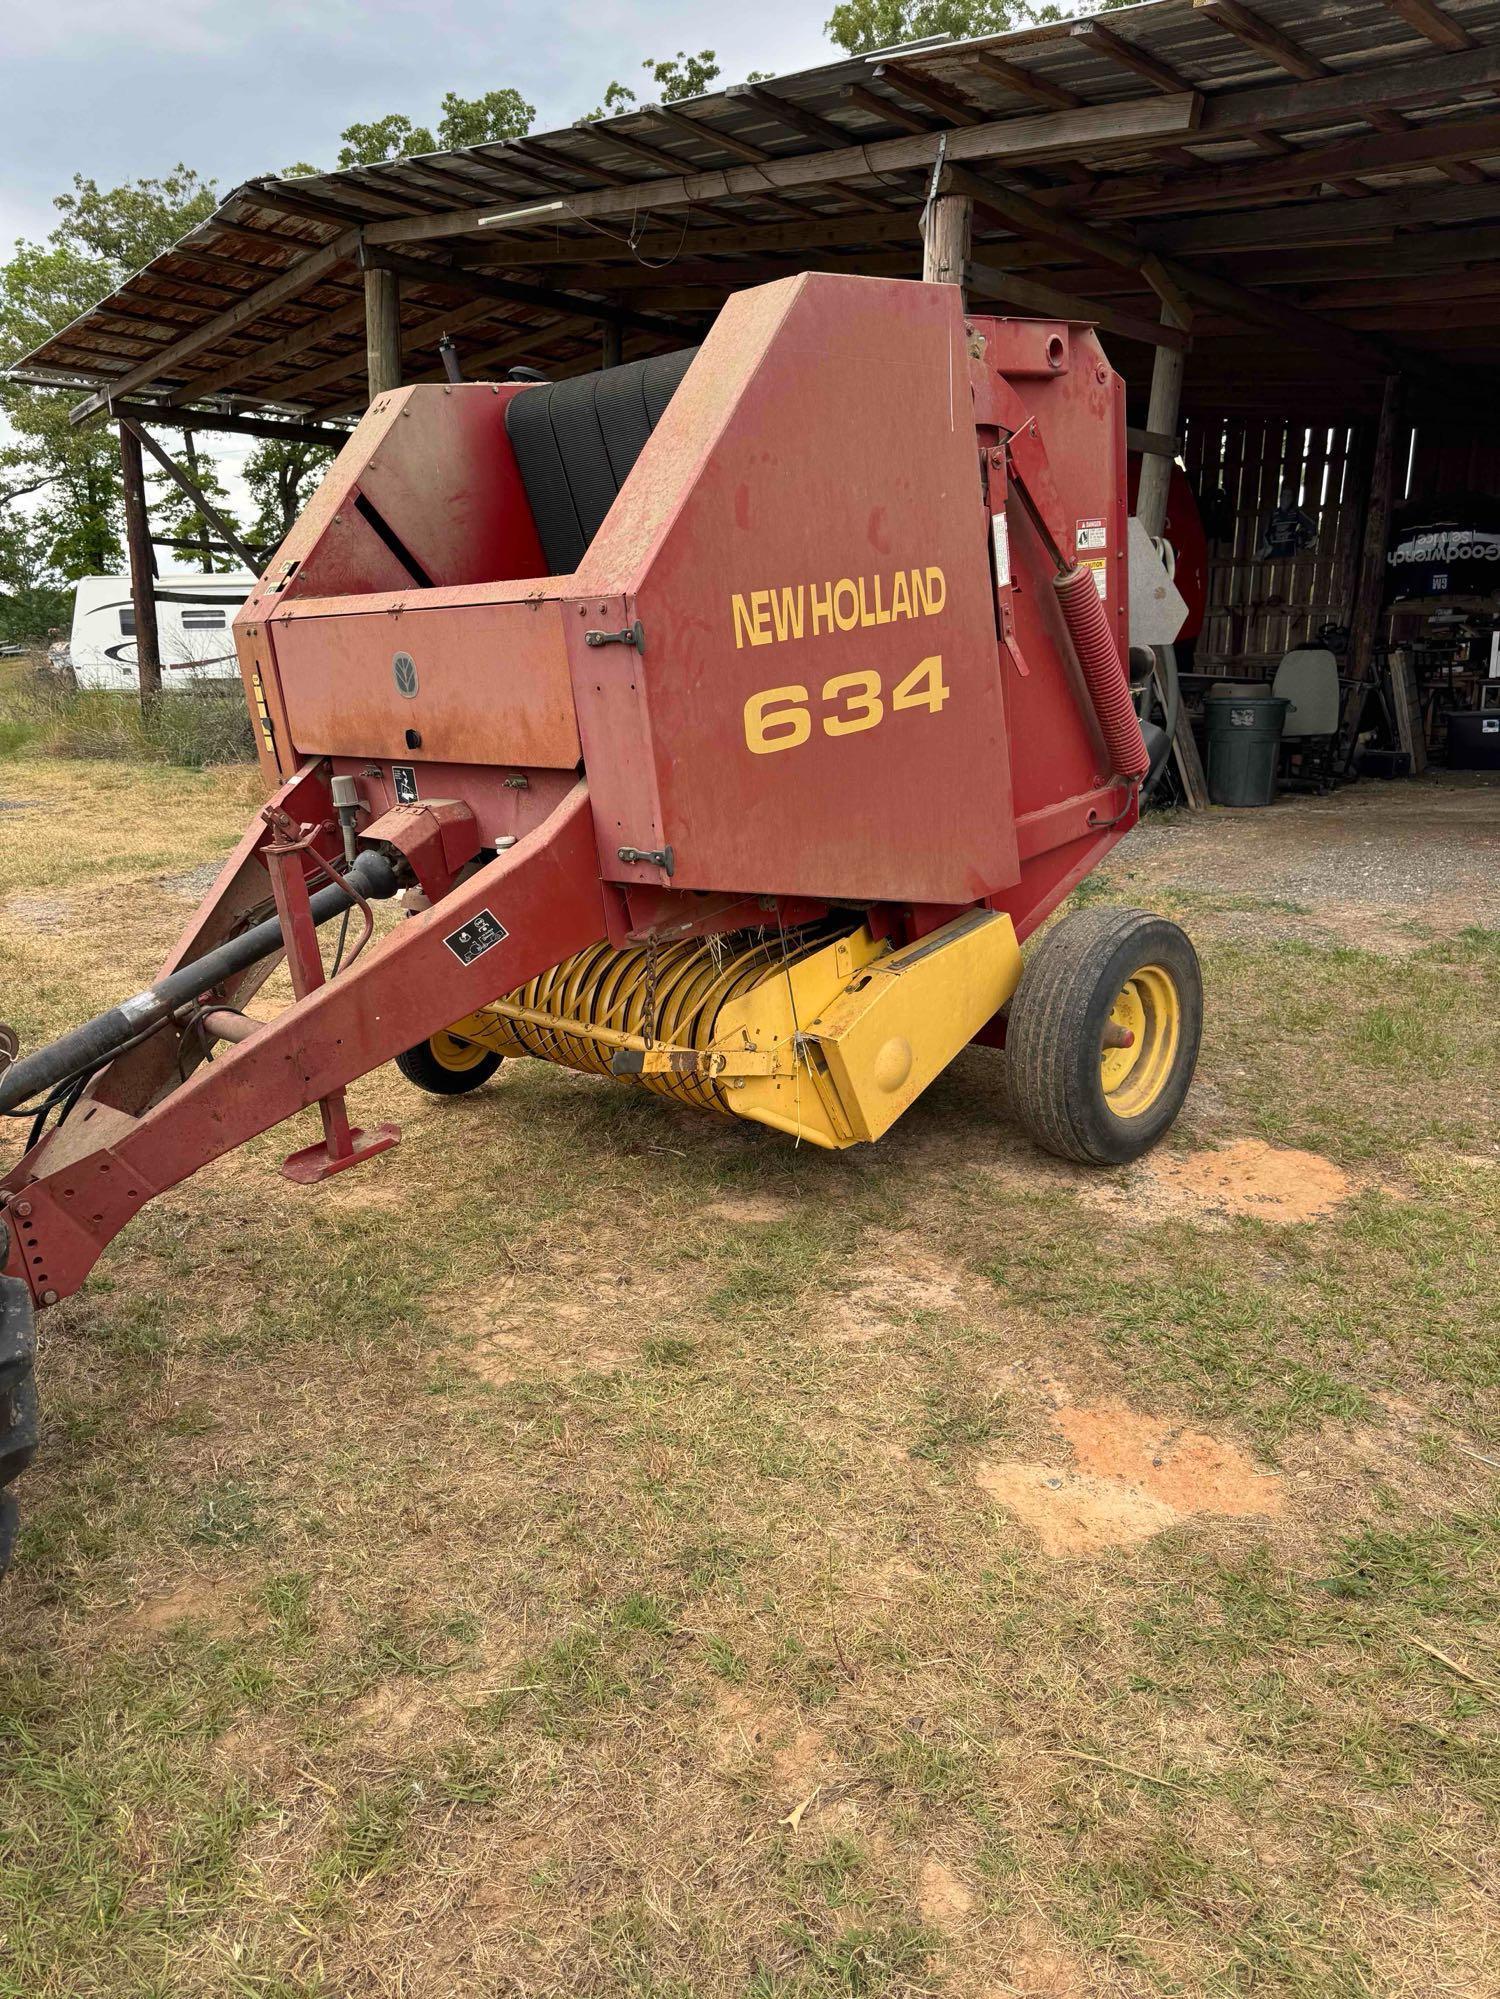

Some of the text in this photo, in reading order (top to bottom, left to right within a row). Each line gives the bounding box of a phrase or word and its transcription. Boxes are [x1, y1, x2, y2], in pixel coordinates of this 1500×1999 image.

[1387, 544, 1500, 567] Goodwrench
[731, 566, 947, 649] NEW HOLLAND
[1432, 577, 1449, 591] GM
[743, 654, 950, 755] 634
